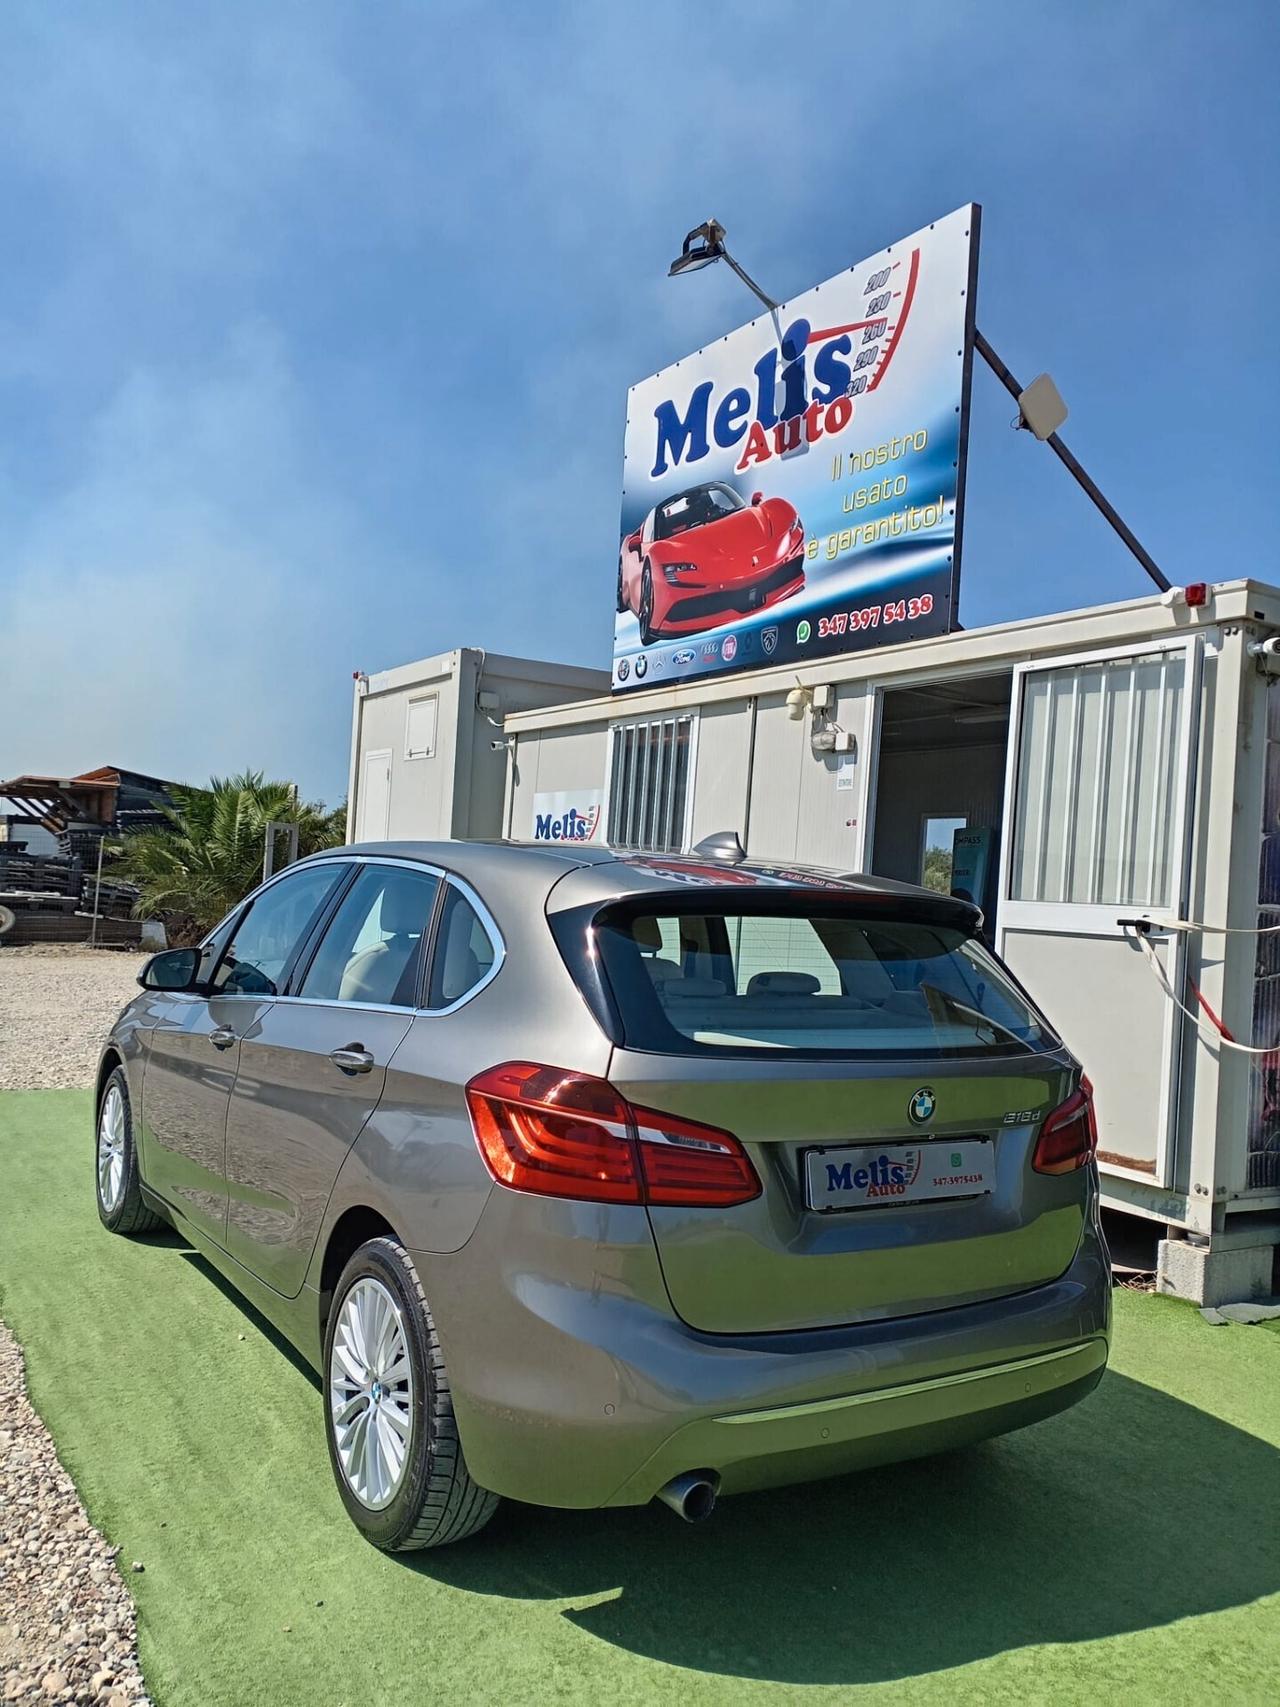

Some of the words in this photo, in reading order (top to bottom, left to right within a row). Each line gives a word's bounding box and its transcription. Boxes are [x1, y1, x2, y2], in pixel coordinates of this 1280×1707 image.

[863, 267, 892, 295] 200
[865, 291, 892, 318] 230
[853, 346, 879, 373] 290
[651, 318, 852, 478] Melis
[736, 396, 852, 470] Auto
[831, 453, 842, 481] Il
[848, 428, 927, 475] nostro
[842, 474, 908, 513] usato
[826, 494, 944, 560] garantito!
[818, 613, 848, 637] 347
[849, 606, 881, 631] 397
[883, 600, 906, 624] 54
[907, 594, 933, 619] 38
[535, 808, 586, 840] Melis
[825, 1155, 904, 1191] Melis
[866, 1183, 905, 1197] Auto
